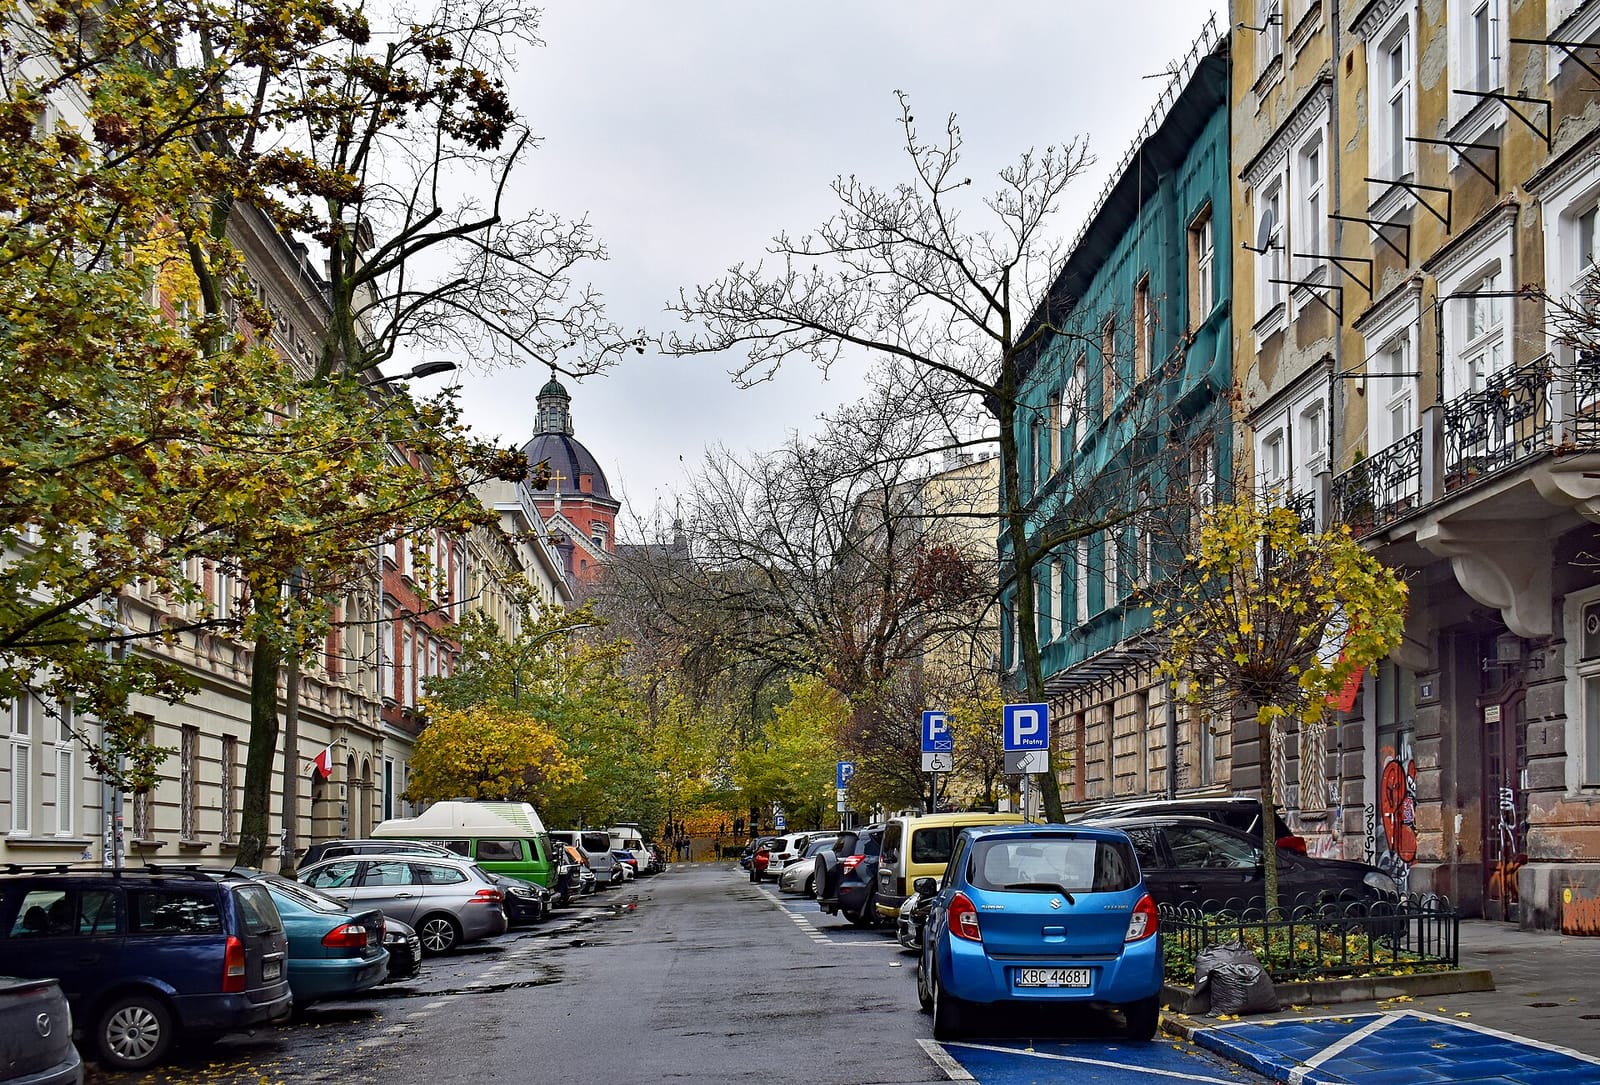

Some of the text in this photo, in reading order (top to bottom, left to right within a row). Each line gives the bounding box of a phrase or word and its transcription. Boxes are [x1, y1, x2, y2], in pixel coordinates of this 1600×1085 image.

[929, 715, 948, 740] P
[1013, 709, 1039, 745] P
[841, 764, 854, 781] P
[777, 817, 784, 826] P
[1022, 970, 1087, 983] KBC 44681
